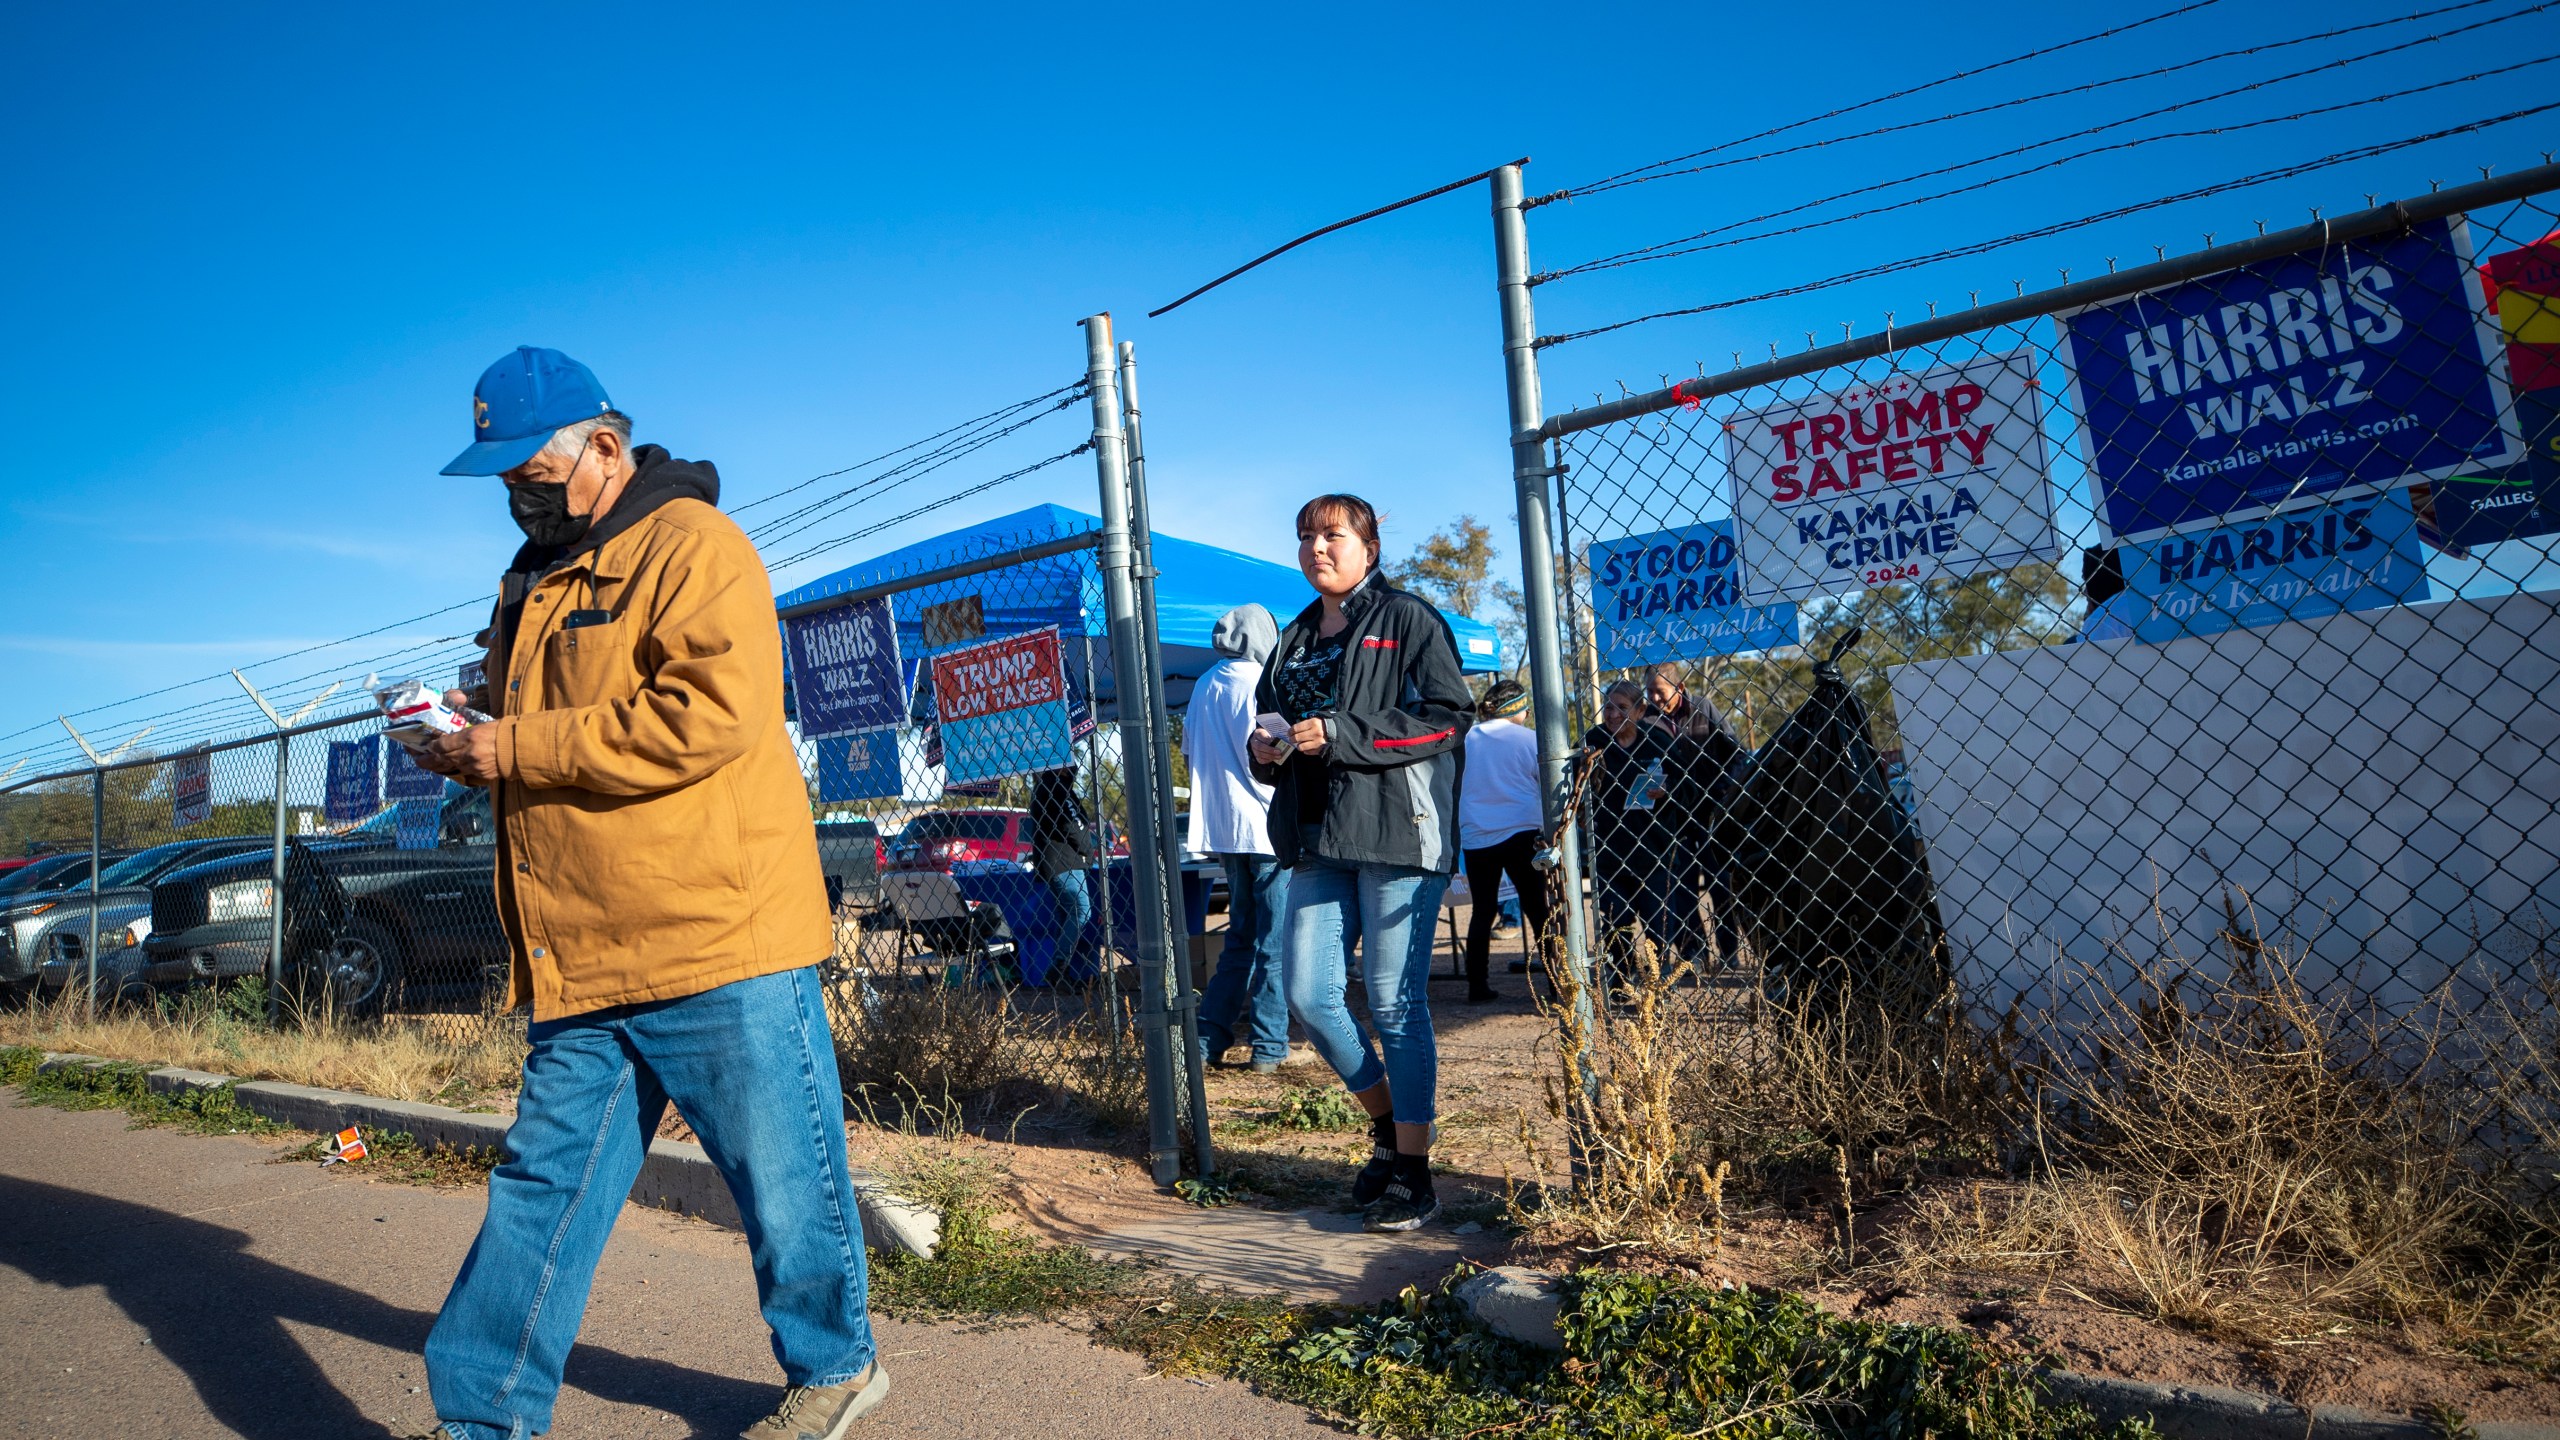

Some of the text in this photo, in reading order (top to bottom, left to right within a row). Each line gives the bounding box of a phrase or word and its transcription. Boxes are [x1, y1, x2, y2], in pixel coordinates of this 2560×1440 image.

[2125, 265, 2403, 403] HARRIS
[1772, 384, 1985, 461] TRUMP
[2184, 360, 2372, 439] WALZ
[1771, 424, 1995, 502] SAFETY
[2163, 412, 2419, 483] KamalaHarris.com
[1797, 487, 1980, 544] KAMALA
[1603, 535, 1736, 587] STOOD
[1825, 523, 1958, 569] CRIME
[2159, 507, 2373, 584] HARRIS
[1866, 563, 1920, 583] 2024
[2149, 554, 2392, 622] Vote Kamala!
[802, 615, 877, 669] HARRIS
[1610, 606, 1776, 652] Vote Kamala!
[821, 663, 871, 692] WALZ
[946, 690, 988, 718] LOW
[992, 676, 1053, 708] TAXES
[954, 650, 1036, 693] TRUMP
[848, 737, 870, 762] AZ
